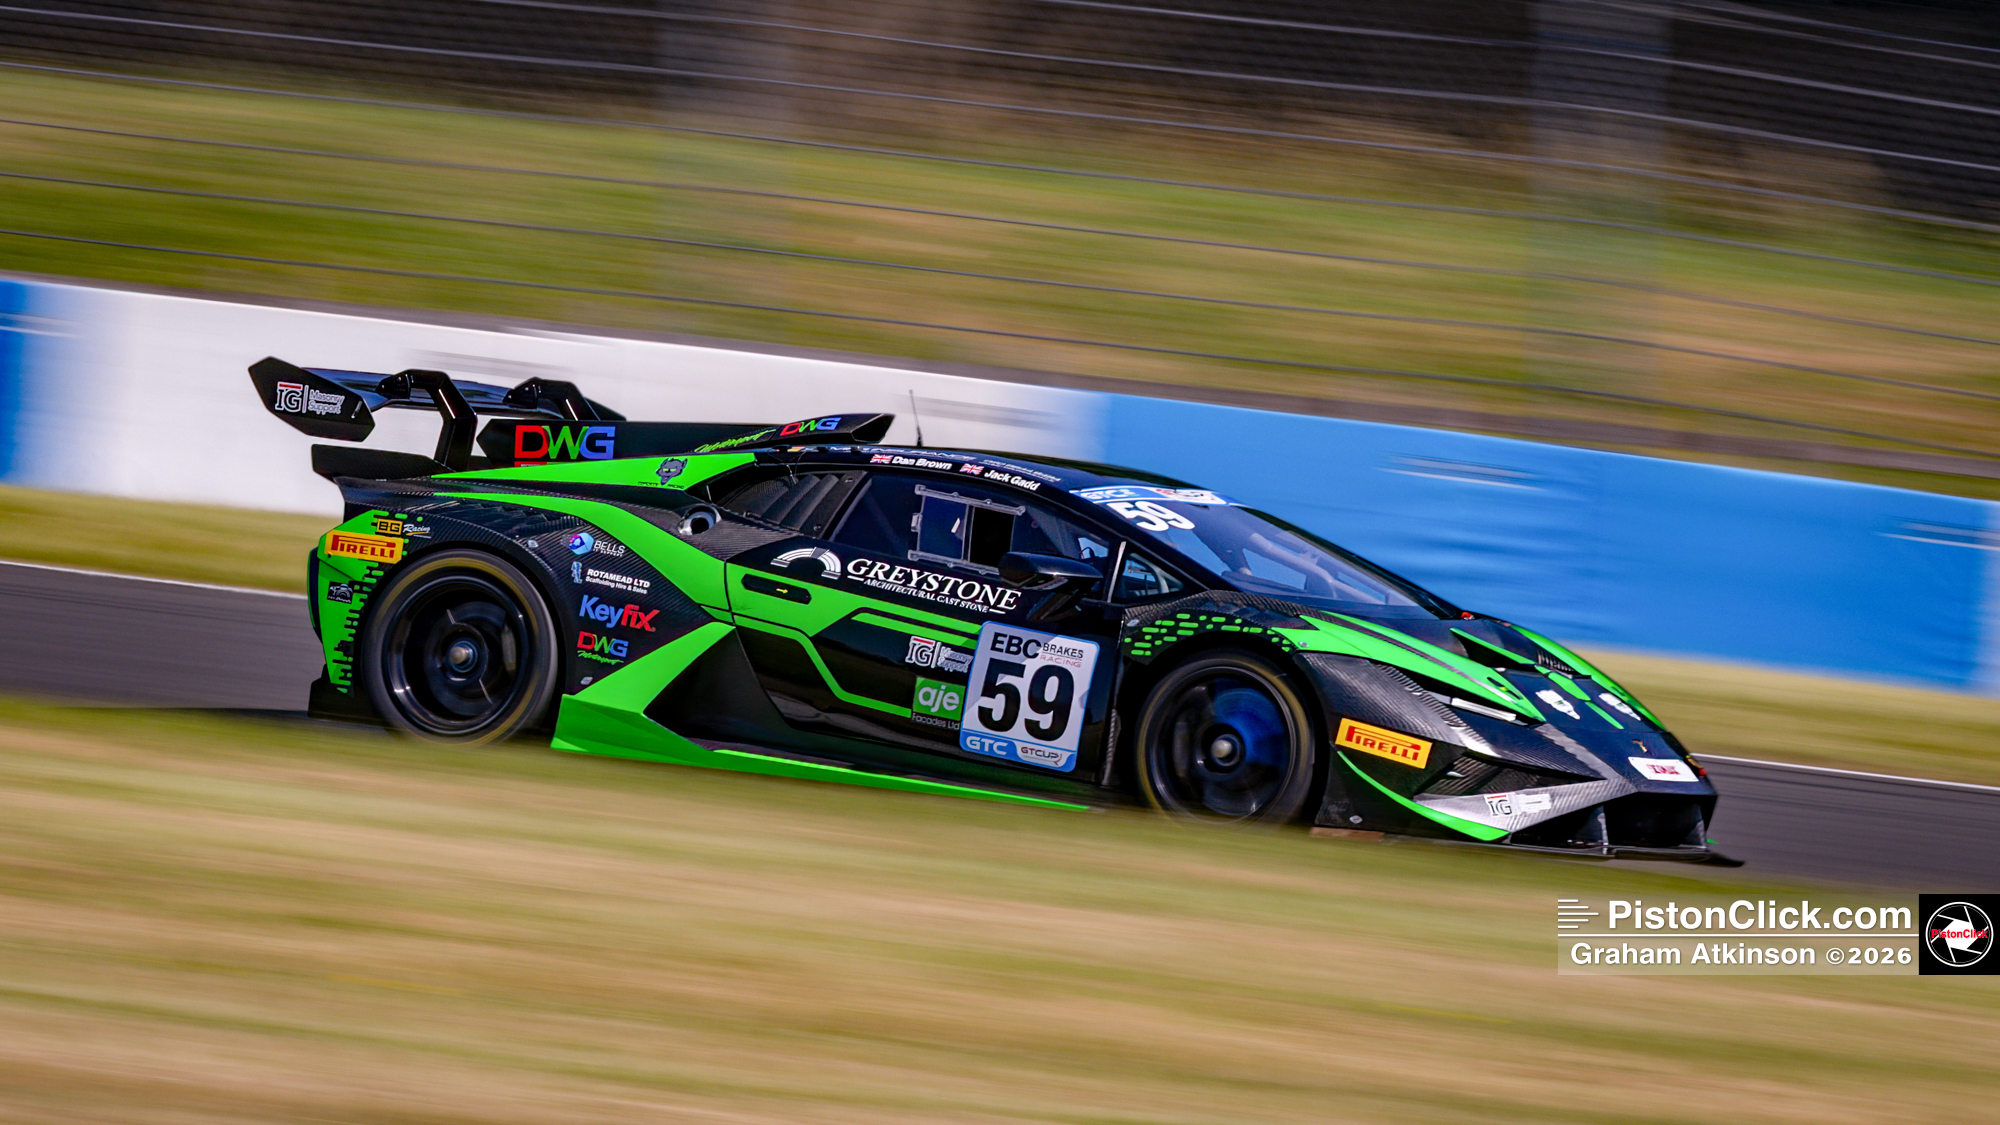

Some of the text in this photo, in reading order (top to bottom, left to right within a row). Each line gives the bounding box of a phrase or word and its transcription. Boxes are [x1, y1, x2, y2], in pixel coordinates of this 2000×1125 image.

[275, 387, 303, 413] IG
[308, 401, 342, 415] Support
[309, 389, 346, 405] Masonry
[780, 417, 842, 437] DWG
[514, 425, 616, 460] DWG
[892, 456, 953, 470] Dan Brown
[984, 469, 1012, 483] Jack
[1010, 475, 1041, 491] Gadd
[1106, 500, 1196, 532] 59
[402, 523, 431, 534] Racing
[331, 534, 397, 559] PIRELLI
[593, 540, 626, 554] BELLS
[585, 576, 616, 589] Scaffolding
[615, 582, 628, 590] Hire
[632, 586, 648, 595] Sales
[586, 568, 634, 585] ROTAMEAD
[633, 578, 651, 588] LTD
[847, 558, 1022, 611] GREYSTONE
[863, 578, 990, 614] ARCHITECTURAL CAST STONE
[578, 594, 660, 632] Keyfix
[577, 631, 629, 658] DWG
[905, 642, 934, 667] IG
[990, 631, 1084, 659] EBC BRAKES
[1039, 653, 1082, 668] RACING
[918, 684, 960, 713] aje
[977, 657, 1075, 742] 59
[912, 712, 961, 731] Facades Ltd
[966, 735, 1009, 756] GTC
[1345, 725, 1422, 761] PIRELLI
[1487, 798, 1513, 817] IG
